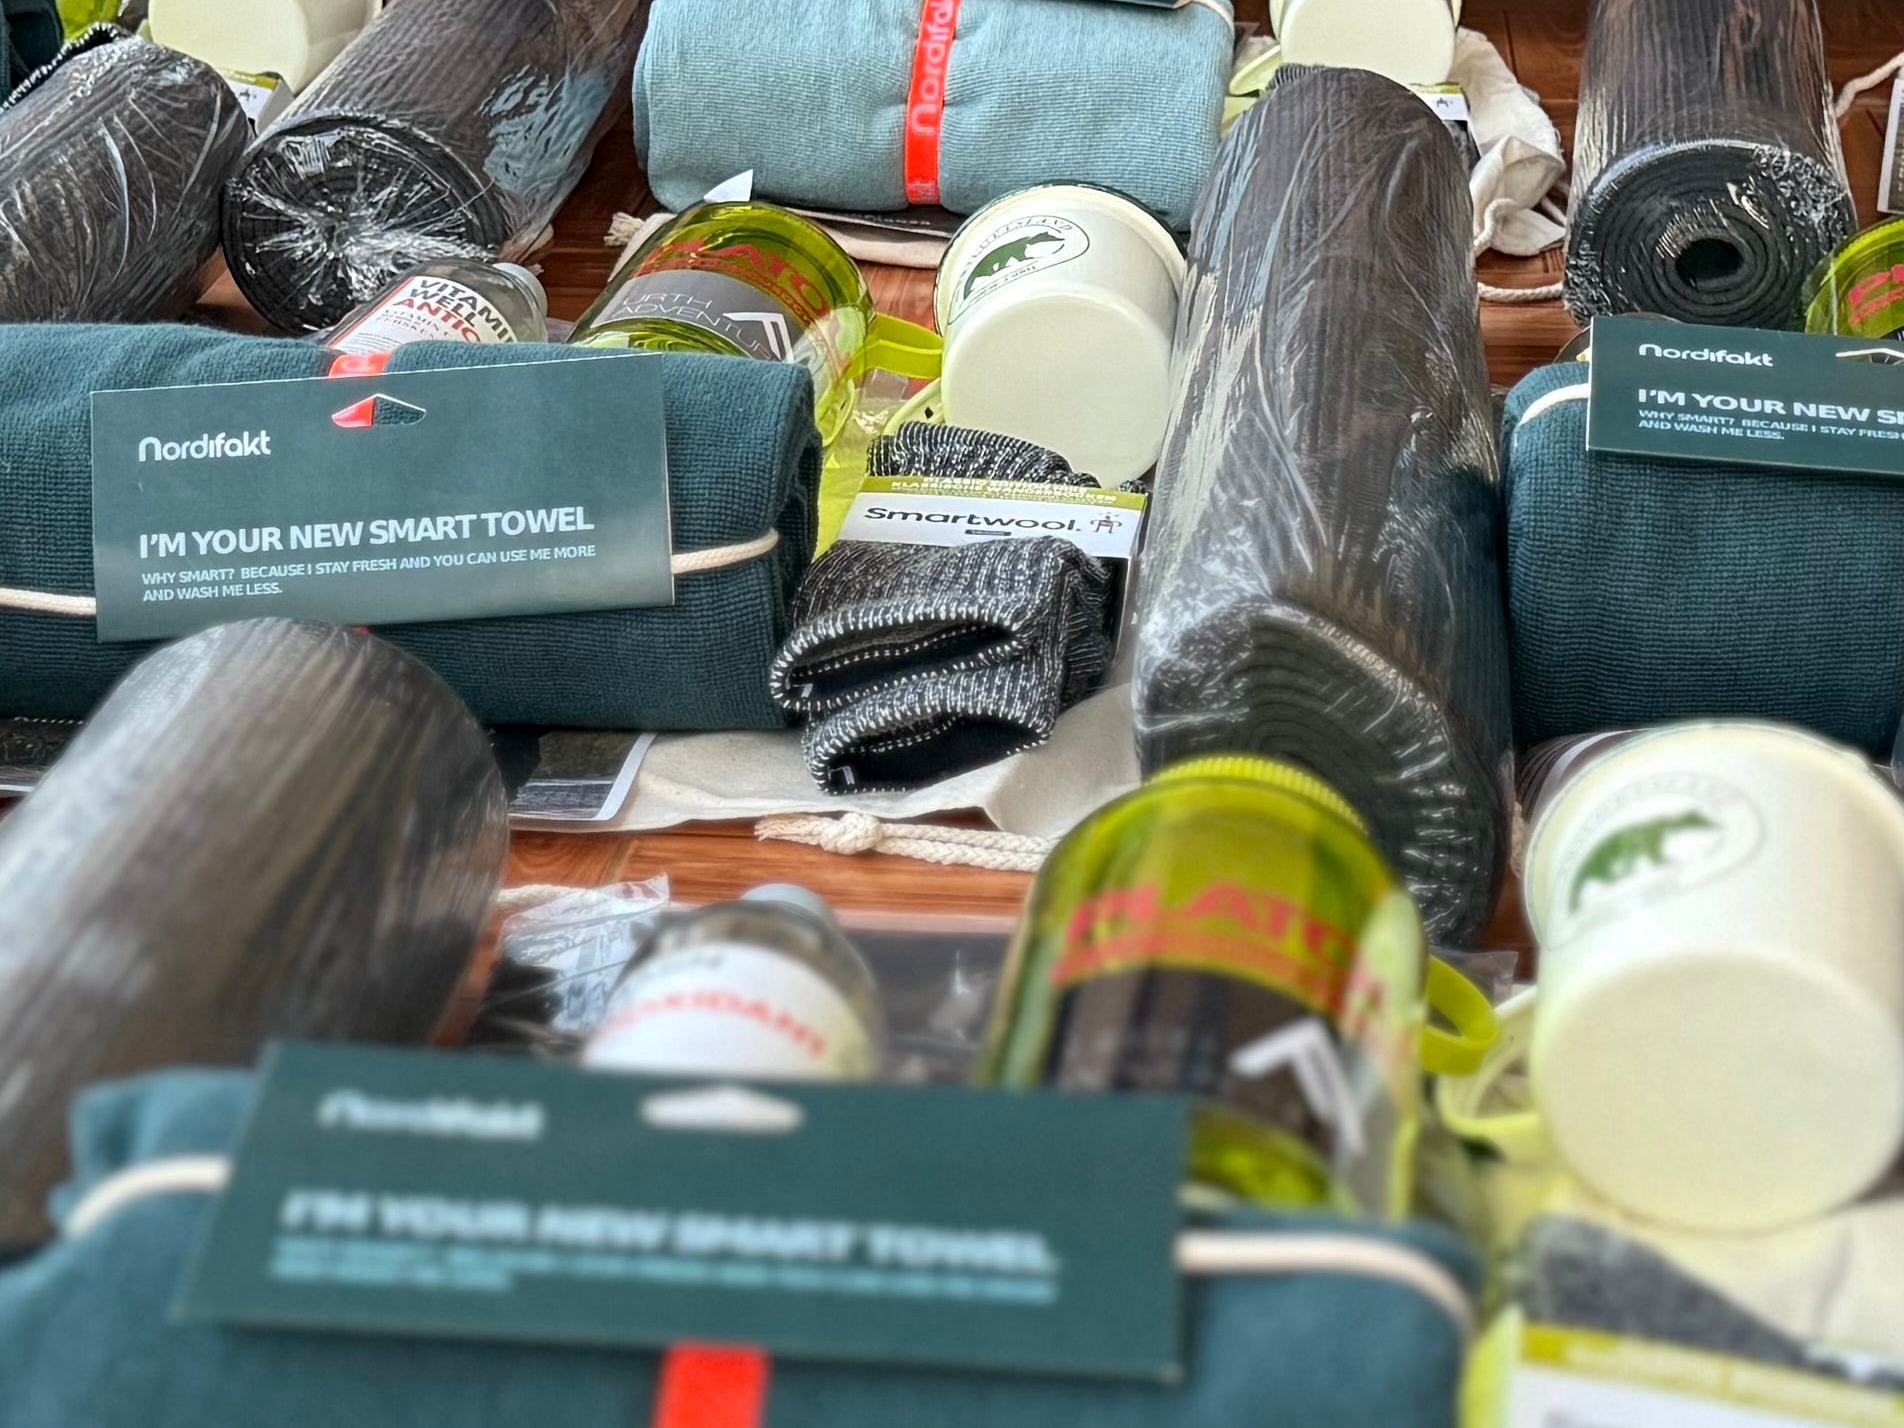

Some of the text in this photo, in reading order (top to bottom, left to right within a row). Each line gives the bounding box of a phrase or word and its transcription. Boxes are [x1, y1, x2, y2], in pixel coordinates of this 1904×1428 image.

[409, 287, 478, 328] WELL
[420, 278, 518, 343] VITAMI
[1638, 343, 1774, 367] Nordifakt
[1638, 388, 1686, 406] I'M
[1691, 392, 1786, 415] YOUR
[1793, 401, 1871, 422] NEW
[1638, 409, 1675, 420] WHY
[1742, 418, 1808, 433] BECAUSE
[1820, 425, 1856, 436] STAY
[1638, 419, 1671, 431] AND
[1673, 422, 1718, 435] WASH
[1721, 427, 1744, 437] ME
[138, 430, 272, 462] Nordifakt
[139, 506, 595, 559] I'M YOUR NEW SMART TOWEL
[142, 572, 177, 585] WHY
[178, 568, 235, 585] SMART?
[241, 564, 305, 580] BECAUSE
[315, 561, 350, 575] STAY
[352, 558, 397, 572] FRESH
[399, 556, 431, 570] AND
[433, 554, 464, 568] YOU
[467, 552, 497, 566] CAN
[500, 549, 527, 563] USE
[530, 548, 551, 561] ME
[554, 545, 597, 559] MORE
[143, 582, 283, 602] AND WASH ME LESS.
